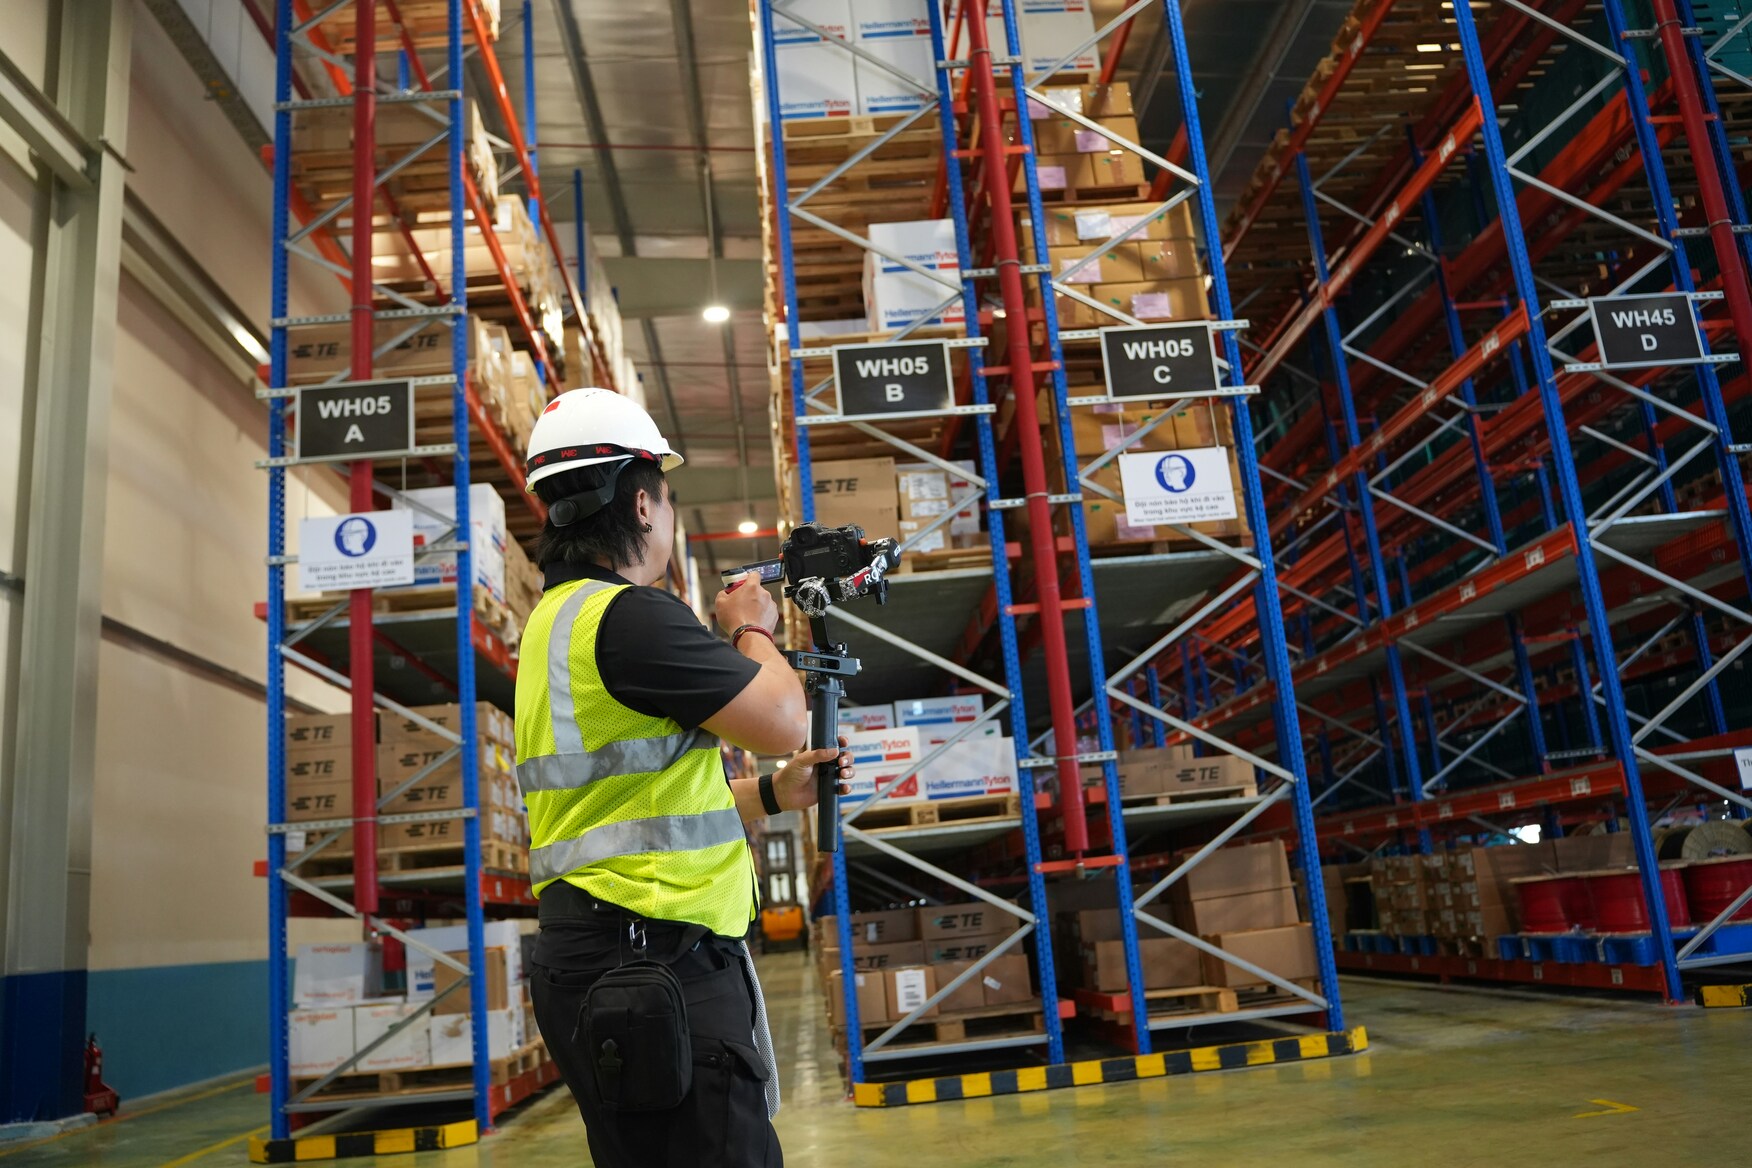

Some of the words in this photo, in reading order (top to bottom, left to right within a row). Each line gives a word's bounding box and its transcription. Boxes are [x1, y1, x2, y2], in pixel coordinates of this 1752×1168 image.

[1611, 308, 1676, 329] WH45
[1123, 339, 1194, 361] WH05
[1640, 333, 1658, 352] D
[855, 356, 929, 379] WH05
[1152, 365, 1172, 384] C
[885, 383, 905, 402] B
[318, 395, 392, 419] WH05
[344, 424, 365, 443] A
